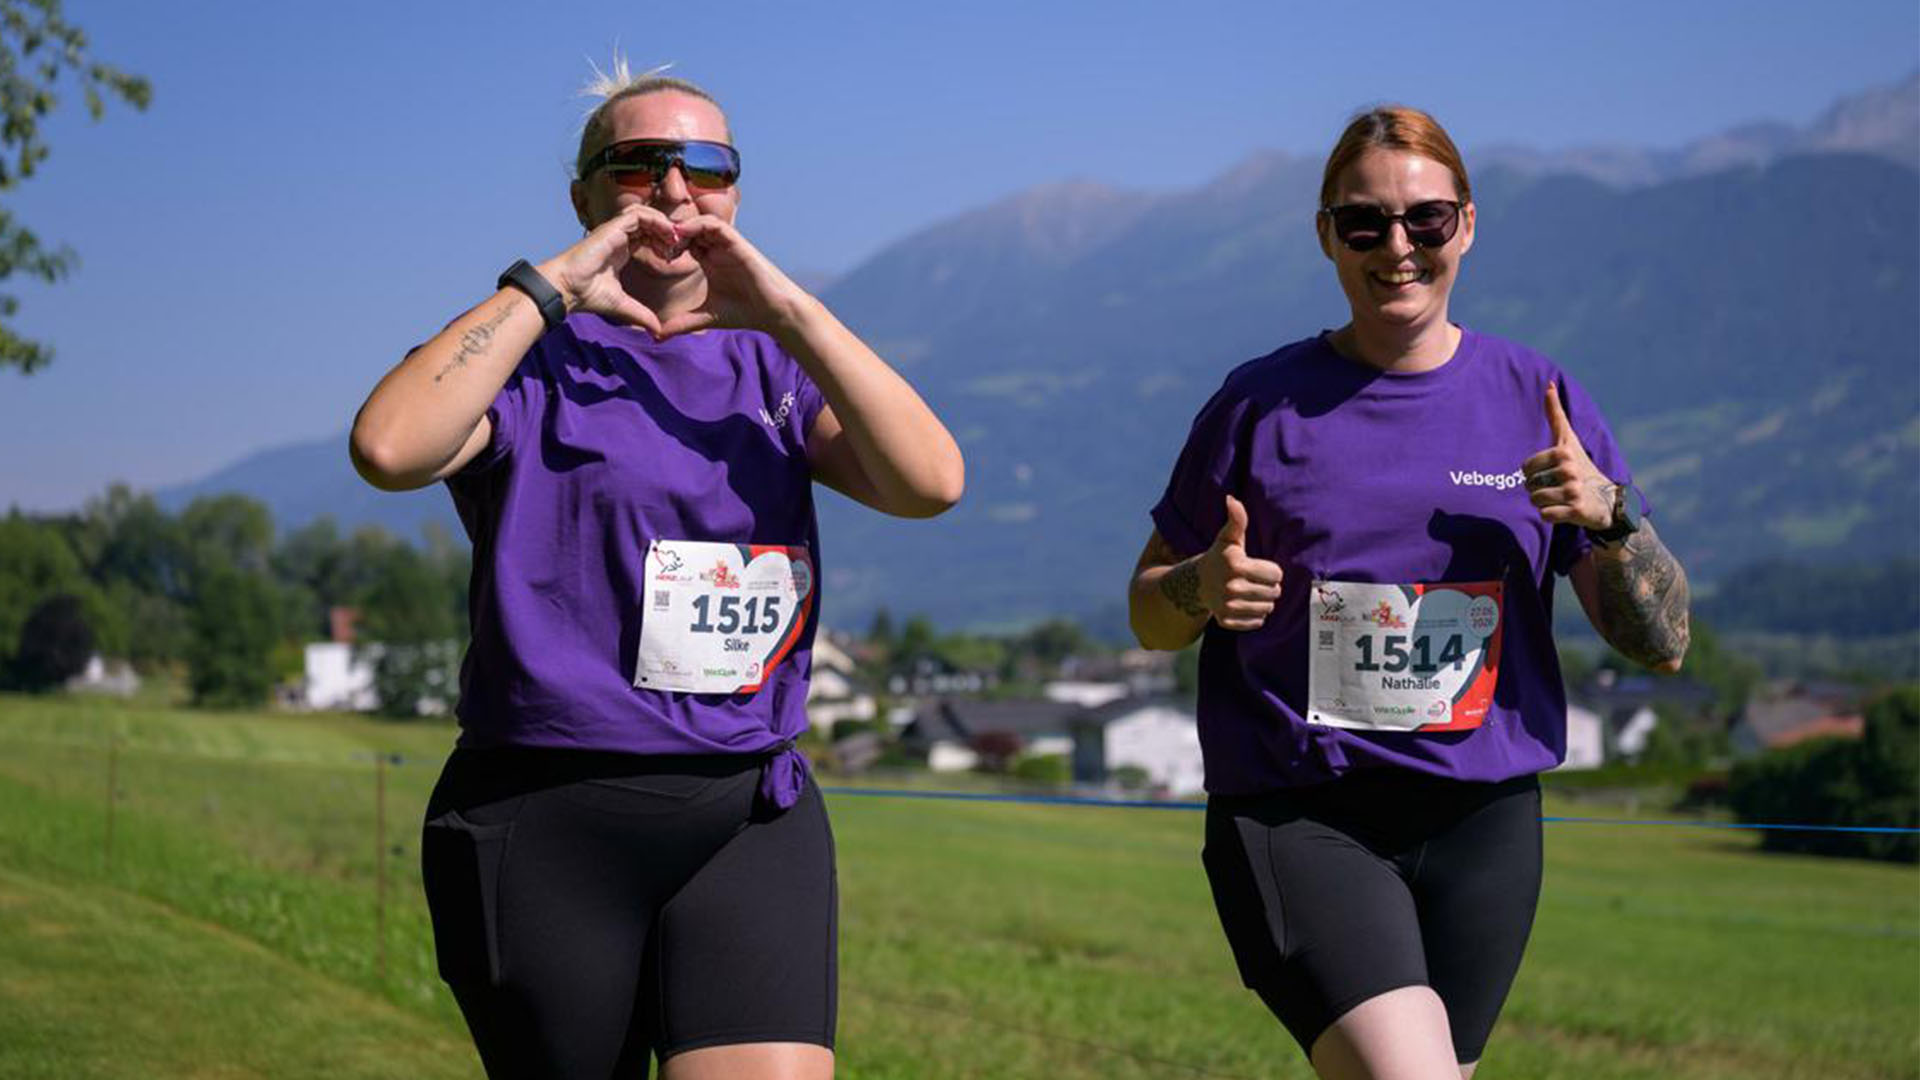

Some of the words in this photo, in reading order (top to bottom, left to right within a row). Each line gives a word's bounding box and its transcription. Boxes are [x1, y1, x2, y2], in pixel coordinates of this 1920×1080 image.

[1449, 470, 1516, 490] Vebego
[690, 595, 780, 634] 1515
[724, 638, 750, 651] Silke
[1355, 634, 1466, 672] 1514
[1381, 677, 1440, 690] Nathalie
